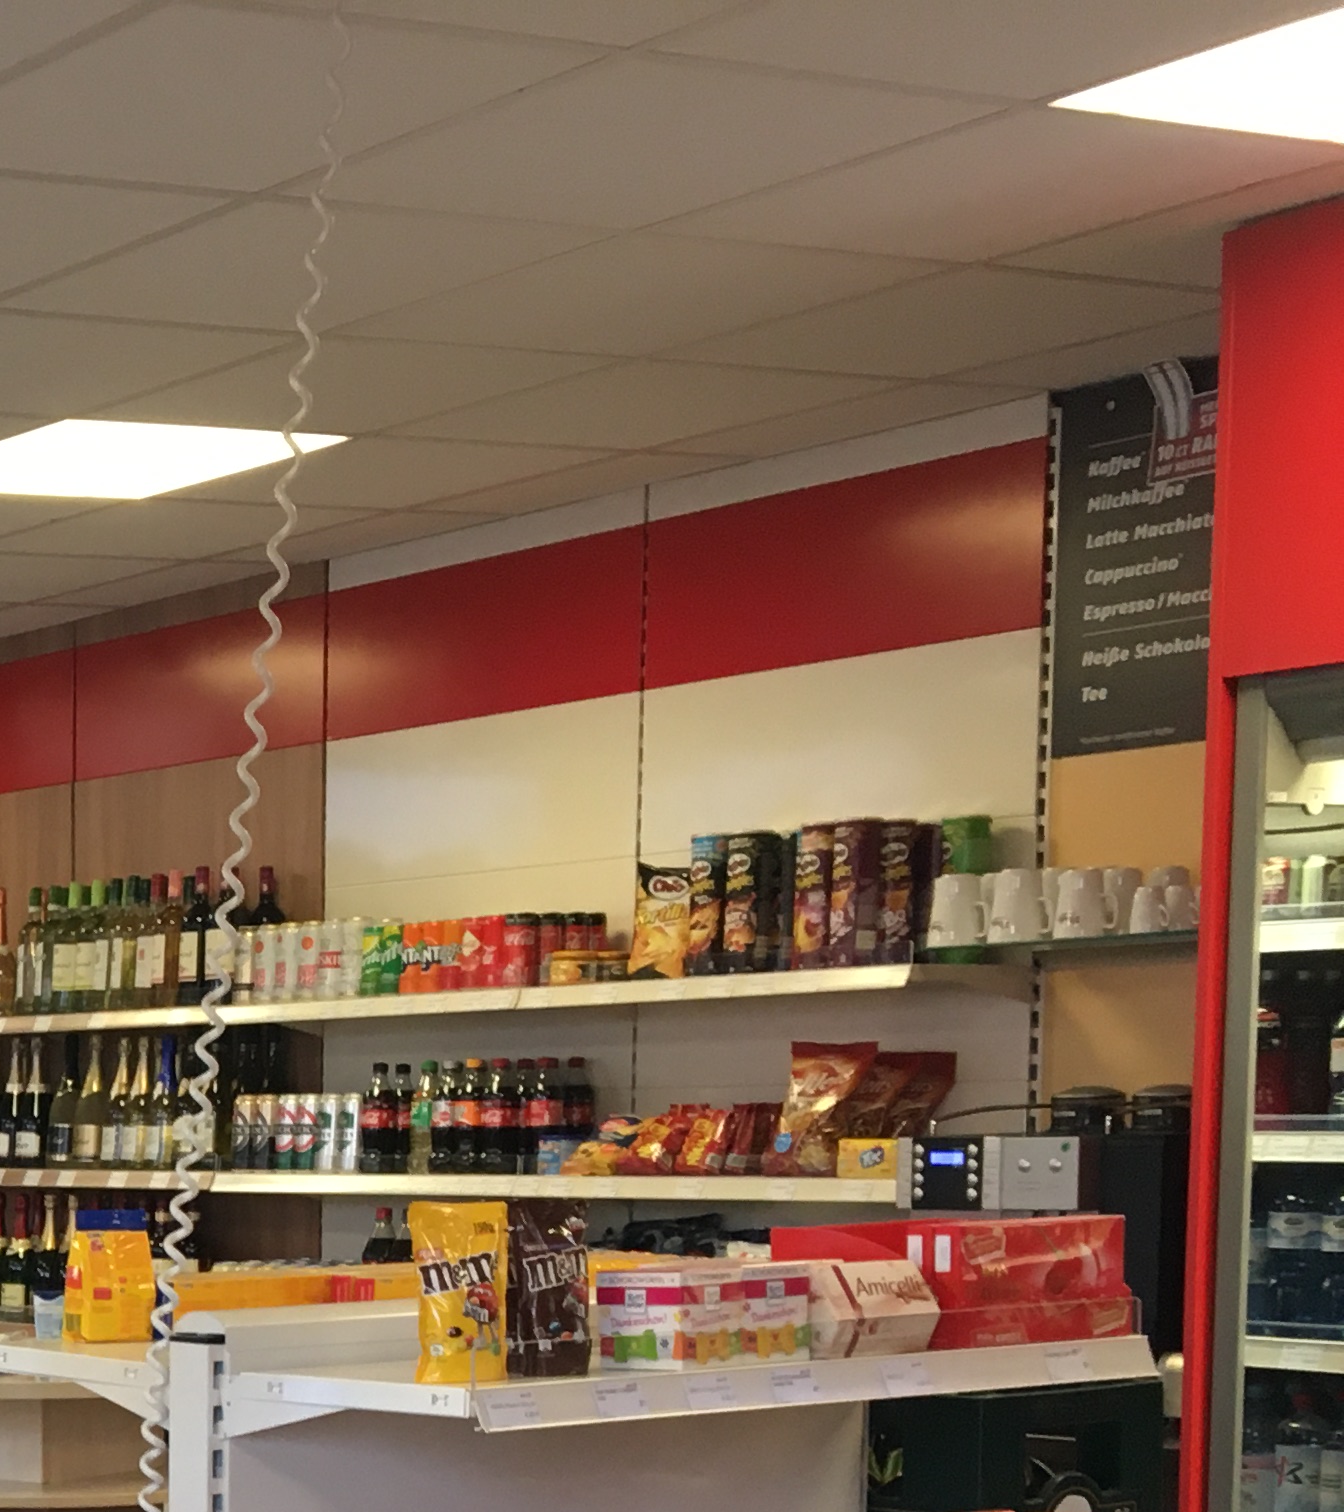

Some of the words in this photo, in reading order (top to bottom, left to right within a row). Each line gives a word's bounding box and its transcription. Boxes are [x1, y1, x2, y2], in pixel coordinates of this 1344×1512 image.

[1088, 454, 1142, 478] Kaffee
[1087, 482, 1185, 514] Milchkaffee
[1085, 529, 1129, 549] Latte
[1084, 556, 1180, 585] Cappuccino
[1081, 646, 1130, 667] Heiße
[1081, 686, 1109, 702] Tee
[855, 1275, 924, 1298] Amicelli
